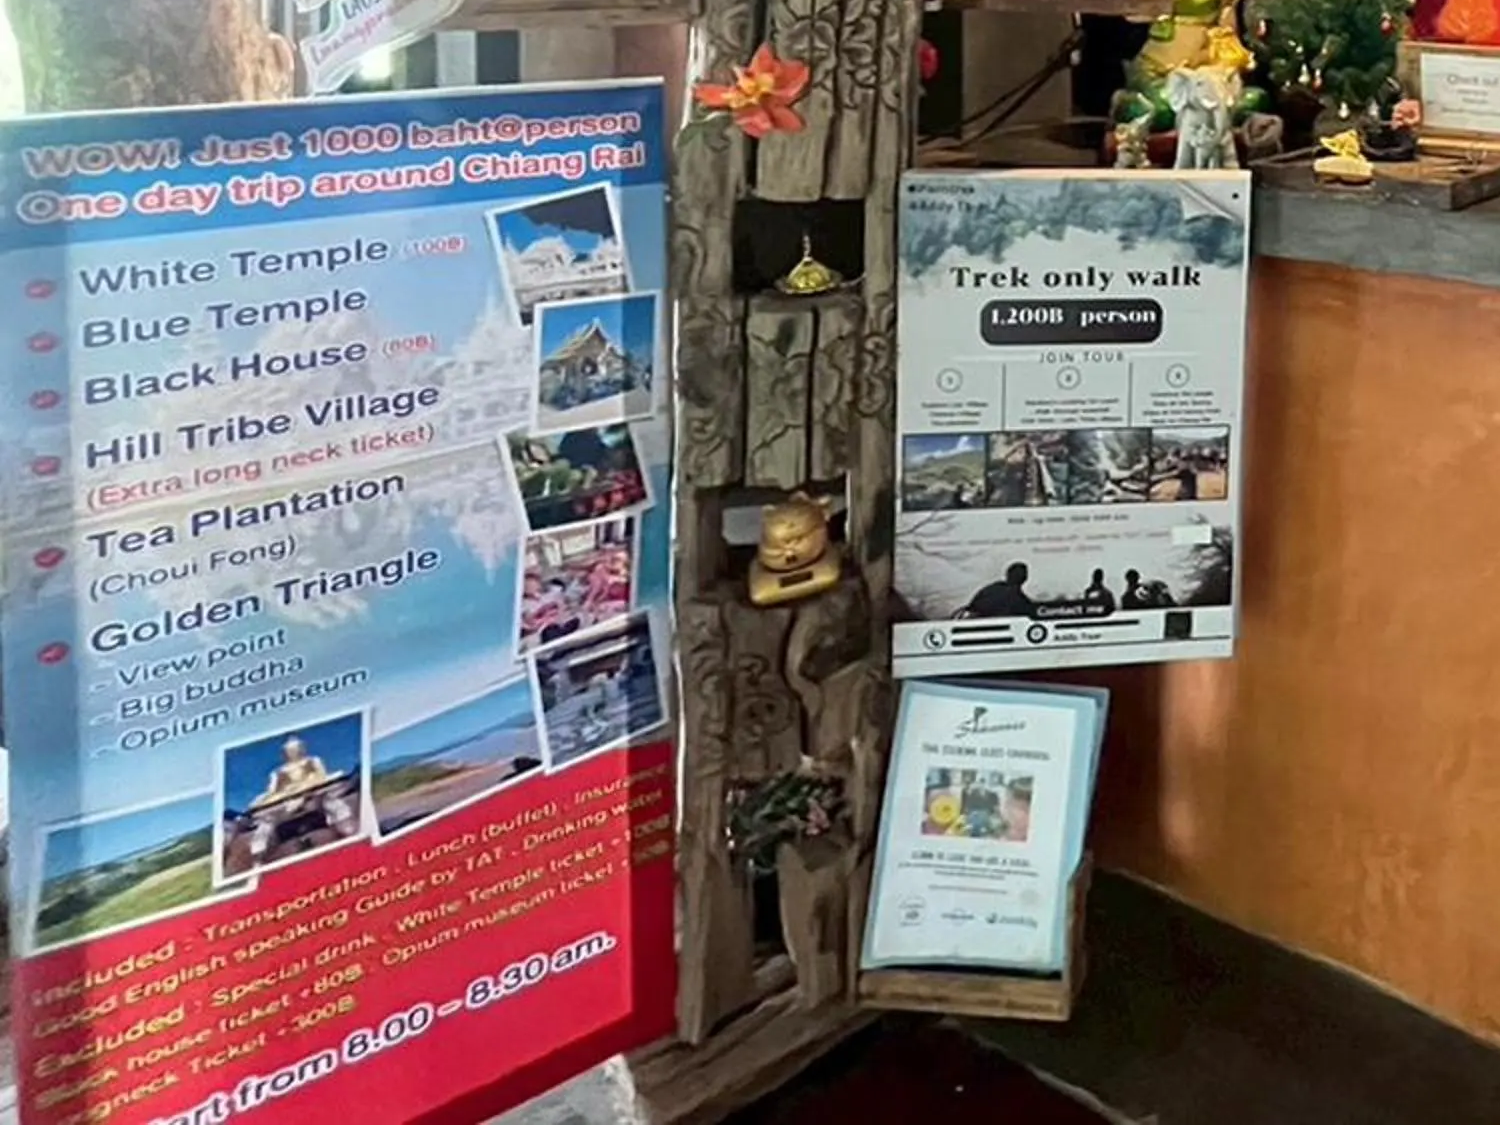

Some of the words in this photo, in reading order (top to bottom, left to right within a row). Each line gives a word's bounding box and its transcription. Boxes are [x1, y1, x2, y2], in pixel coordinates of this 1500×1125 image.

[17, 192, 125, 223] One
[133, 182, 220, 215] day
[228, 174, 303, 208] trip
[311, 160, 454, 197] around
[463, 148, 585, 181] Chiang
[591, 142, 646, 171] Rai
[25, 139, 180, 178] WOW!
[192, 133, 291, 164] Just
[301, 125, 399, 156] 1000
[409, 112, 640, 148] baht@person
[80, 261, 216, 296] White
[230, 238, 388, 277] Temple
[949, 267, 1030, 288] Trek
[1043, 266, 1115, 291] only
[1127, 266, 1201, 287] walk
[83, 315, 190, 349] Blue
[207, 289, 367, 329] Temple
[1080, 309, 1157, 327] person
[84, 362, 216, 405] Black
[231, 342, 367, 381] House
[1039, 352, 1075, 363] JOIN
[1083, 351, 1125, 362] TOUR
[86, 431, 162, 469] Hill
[179, 414, 292, 451] Tribe
[305, 386, 440, 426] Village
[86, 474, 182, 511] (Extra
[194, 458, 261, 488] long
[272, 438, 343, 470] neck
[350, 424, 435, 455] ticket)
[86, 524, 174, 559] Tea
[191, 474, 405, 538] Plantation
[89, 561, 198, 603] (Choui
[210, 534, 296, 572] Fong)
[91, 594, 260, 653] Golden
[275, 549, 439, 606] Triangle
[119, 654, 197, 686] View
[207, 628, 285, 667] point
[119, 691, 174, 720] Big
[185, 655, 303, 701] buddha
[120, 708, 229, 751] Opium
[239, 667, 368, 717] museum
[124, 953, 227, 1004] English
[232, 909, 349, 962] speaking
[354, 879, 425, 914] Guide
[431, 867, 459, 885] by
[465, 846, 502, 872] TAT
[523, 811, 607, 852] Drinking
[203, 866, 387, 942] Transportation
[407, 833, 476, 868] Lunch
[33, 1004, 186, 1077] Excluded
[209, 958, 308, 1009] Special
[314, 932, 377, 966] drink
[395, 898, 465, 933] White
[465, 865, 546, 905] Temple
[550, 841, 604, 873] ticket
[218, 993, 290, 1036] ticket
[382, 927, 459, 967] Opium
[464, 886, 556, 934] museum
[560, 862, 614, 895] ticket
[188, 1032, 266, 1074] Ticket
[235, 1049, 337, 1111] from
[466, 953, 548, 1009] 8.30
[552, 931, 617, 973] am.
